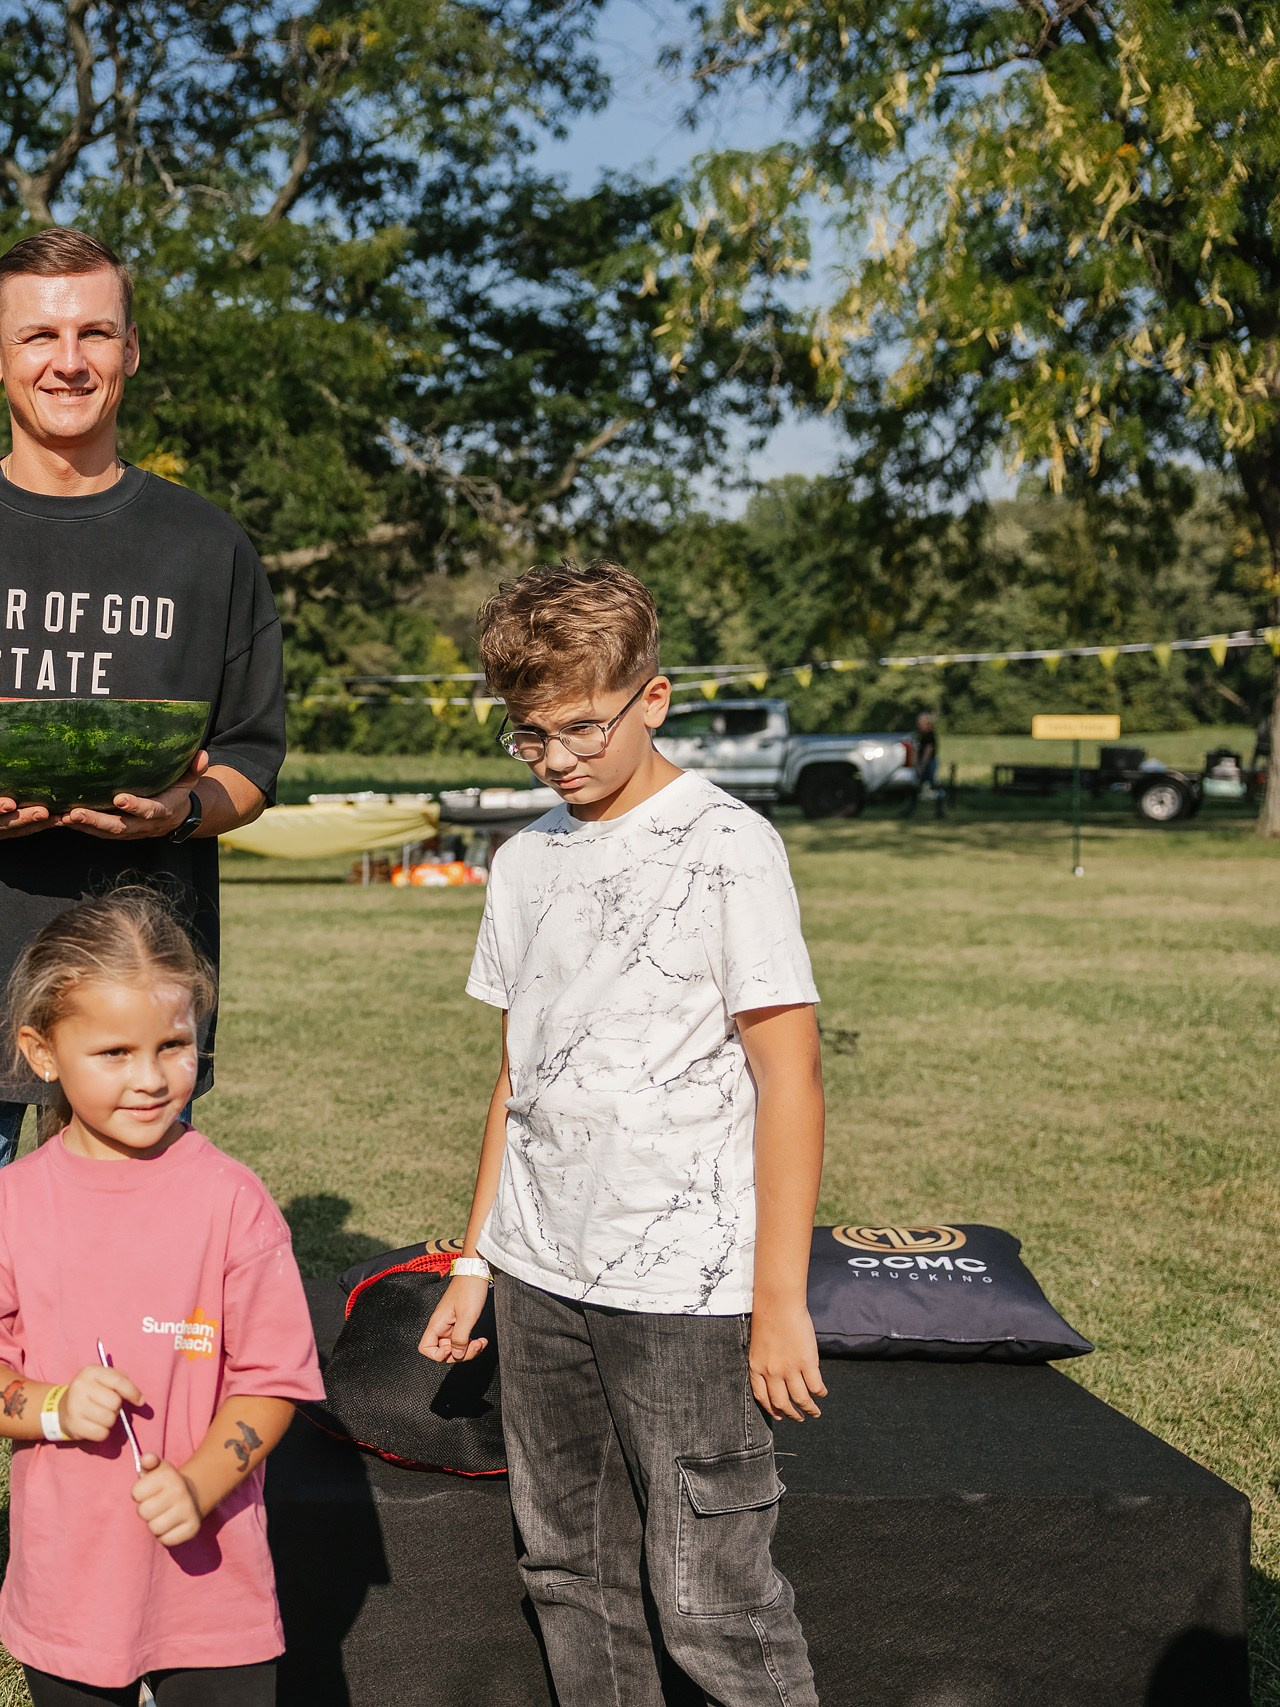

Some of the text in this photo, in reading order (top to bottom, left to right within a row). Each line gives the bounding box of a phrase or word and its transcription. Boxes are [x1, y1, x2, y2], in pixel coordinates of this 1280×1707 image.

[43, 591, 90, 633] OF
[102, 593, 175, 640] GOD
[847, 1256, 987, 1272] OCMC
[852, 1270, 993, 1284] TRUCKING
